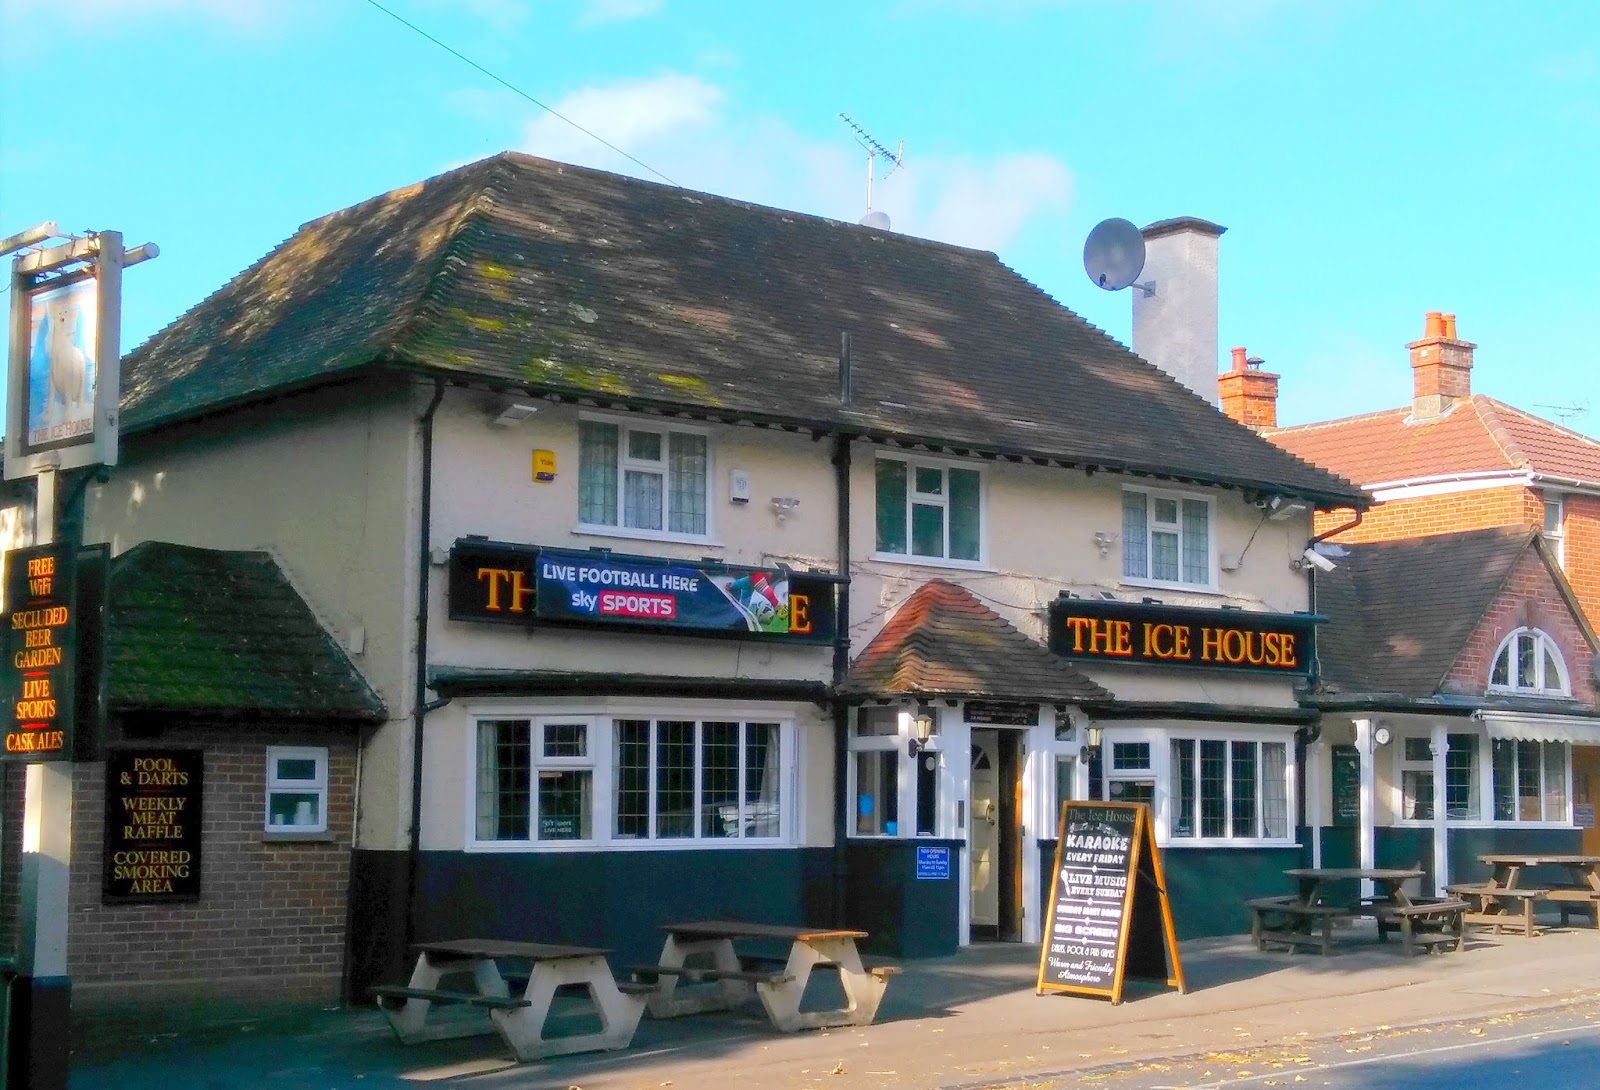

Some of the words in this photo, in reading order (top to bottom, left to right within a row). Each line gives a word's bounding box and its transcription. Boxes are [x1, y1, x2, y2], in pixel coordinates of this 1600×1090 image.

[28, 557, 54, 577] FREE
[543, 564, 576, 582] LIVE
[578, 567, 659, 588] FOOTBALL
[662, 574, 699, 592] HERE
[478, 568, 538, 613] TH
[572, 590, 598, 612] sky
[602, 594, 672, 615] SPORTS
[12, 606, 68, 630] SECLUDED
[25, 629, 51, 648] BEER
[1066, 617, 1133, 656] THE
[1143, 622, 1191, 660] ICE
[1200, 628, 1296, 668] HOUSE
[14, 648, 62, 669] GARDEN
[23, 680, 50, 699] LIVE
[16, 699, 56, 720] SPORTS
[6, 732, 34, 751] CASK
[36, 731, 64, 750] ALES
[134, 758, 176, 772] POOL
[120, 772, 132, 785] &
[138, 772, 188, 785] DARTS
[122, 797, 187, 811] WEEKLY
[132, 811, 176, 825] MEAT
[1070, 808, 1086, 820] The
[1088, 810, 1102, 820] Ice
[1106, 810, 1136, 822] House
[124, 826, 183, 839] RAFFLE
[1066, 834, 1128, 851] KARAOKE
[114, 850, 190, 865] COVERED
[1066, 852, 1093, 862] EVERY
[1094, 854, 1124, 864] FRIDAY
[114, 865, 190, 880] SMOKING
[1069, 873, 1092, 884] LIVE
[1094, 876, 1126, 887] MUSIC
[130, 880, 173, 893] AREA
[1070, 886, 1095, 896] EVERY
[1095, 888, 1125, 898] SUNDAY
[1075, 925, 1118, 938] SCREEN
[1067, 945, 1084, 955] POOL
[1048, 956, 1070, 968] Warm
[1070, 961, 1084, 970] and
[1085, 961, 1114, 976] Friendly
[1058, 970, 1101, 983] Atmosphere
